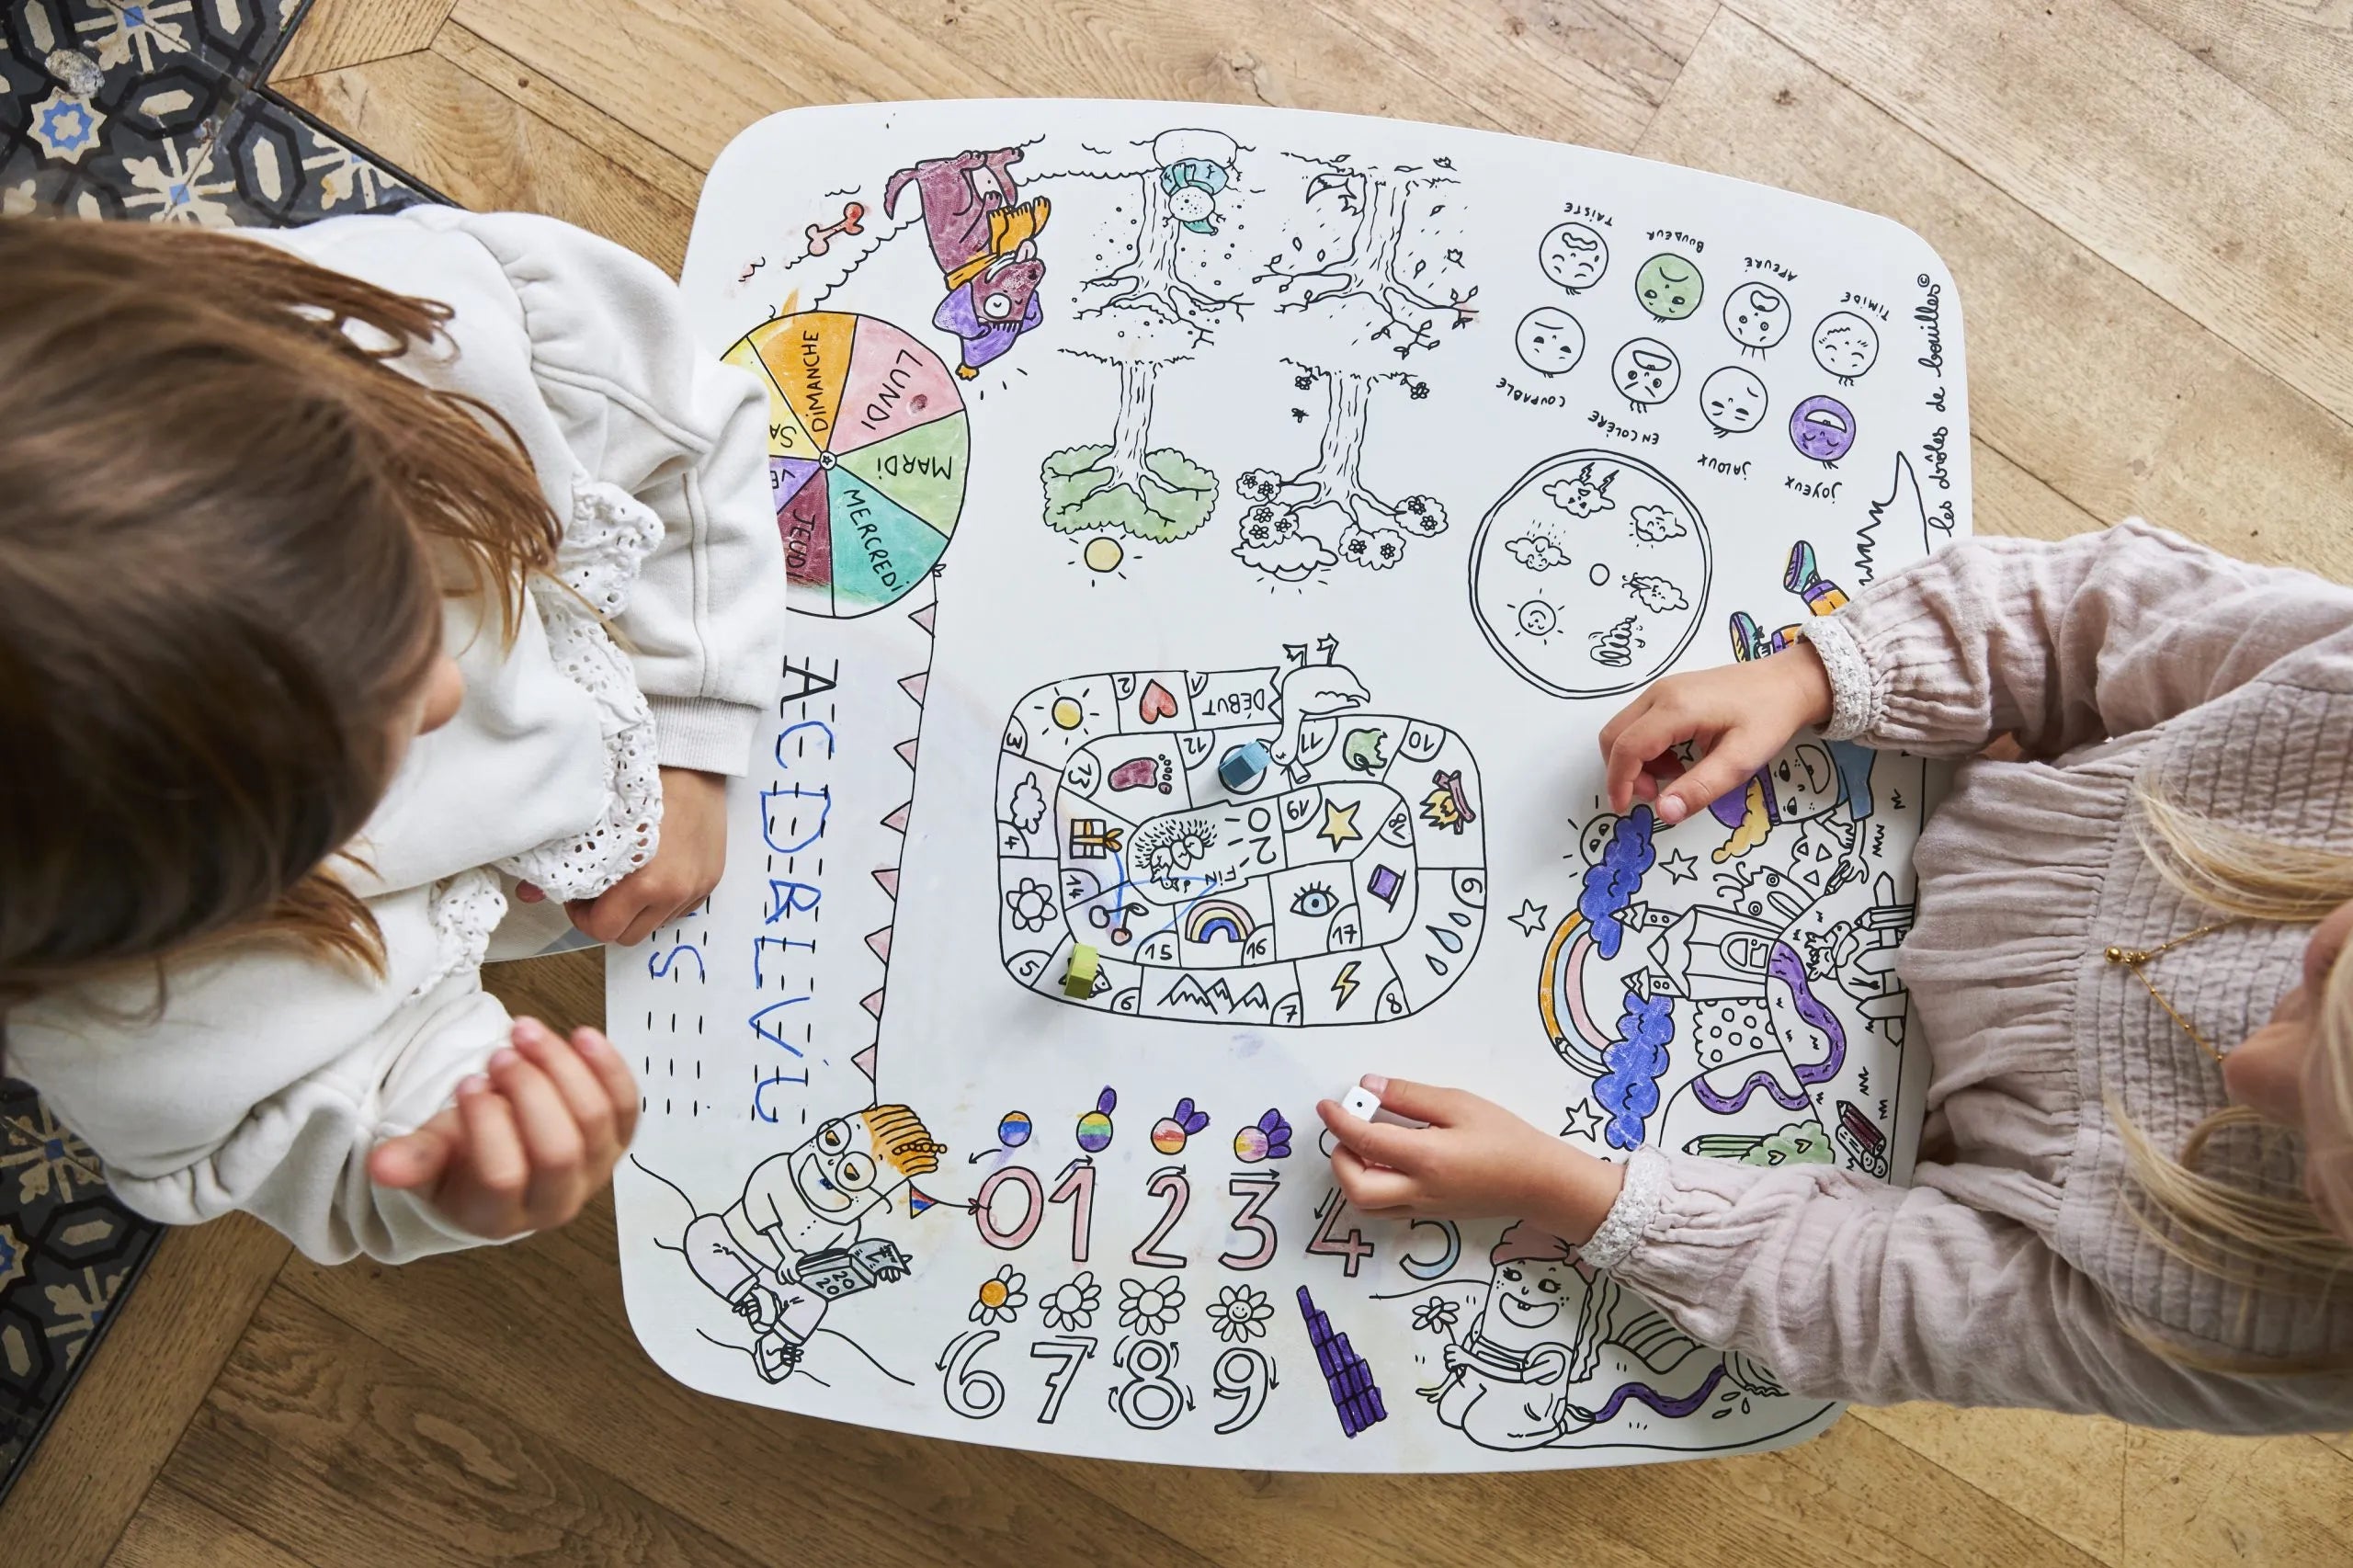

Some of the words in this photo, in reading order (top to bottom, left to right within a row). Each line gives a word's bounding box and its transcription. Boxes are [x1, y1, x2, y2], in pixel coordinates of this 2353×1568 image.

[861, 349, 923, 430] LUNDI
[1495, 377, 1566, 408] COUPABLE
[1925, 386, 1947, 413] de
[1923, 426, 1950, 490] drôles
[1117, 676, 1131, 694] 2
[1201, 687, 1265, 720] DÉBUT
[1006, 733, 1023, 749] 3
[1183, 736, 1207, 755] 12
[1301, 732, 1324, 753] 11
[1408, 731, 1435, 752] 10
[1067, 764, 1092, 789] 13
[1287, 799, 1310, 820] 19
[1004, 835, 1020, 850] 4
[1333, 924, 1358, 945] 17
[1144, 943, 1174, 960] 15
[1245, 937, 1267, 959] 16
[1018, 960, 1040, 977] 5
[1120, 994, 1136, 1011] 6
[1385, 992, 1402, 1015] 8
[1280, 1004, 1298, 1023] 7
[1132, 1174, 1189, 1268] 2
[1218, 1179, 1280, 1270] 3
[1306, 1187, 1374, 1278] 4
[943, 1330, 1005, 1419] 6
[1030, 1341, 1089, 1424] 7
[1119, 1339, 1184, 1429] 8
[1214, 1347, 1267, 1435] 9
